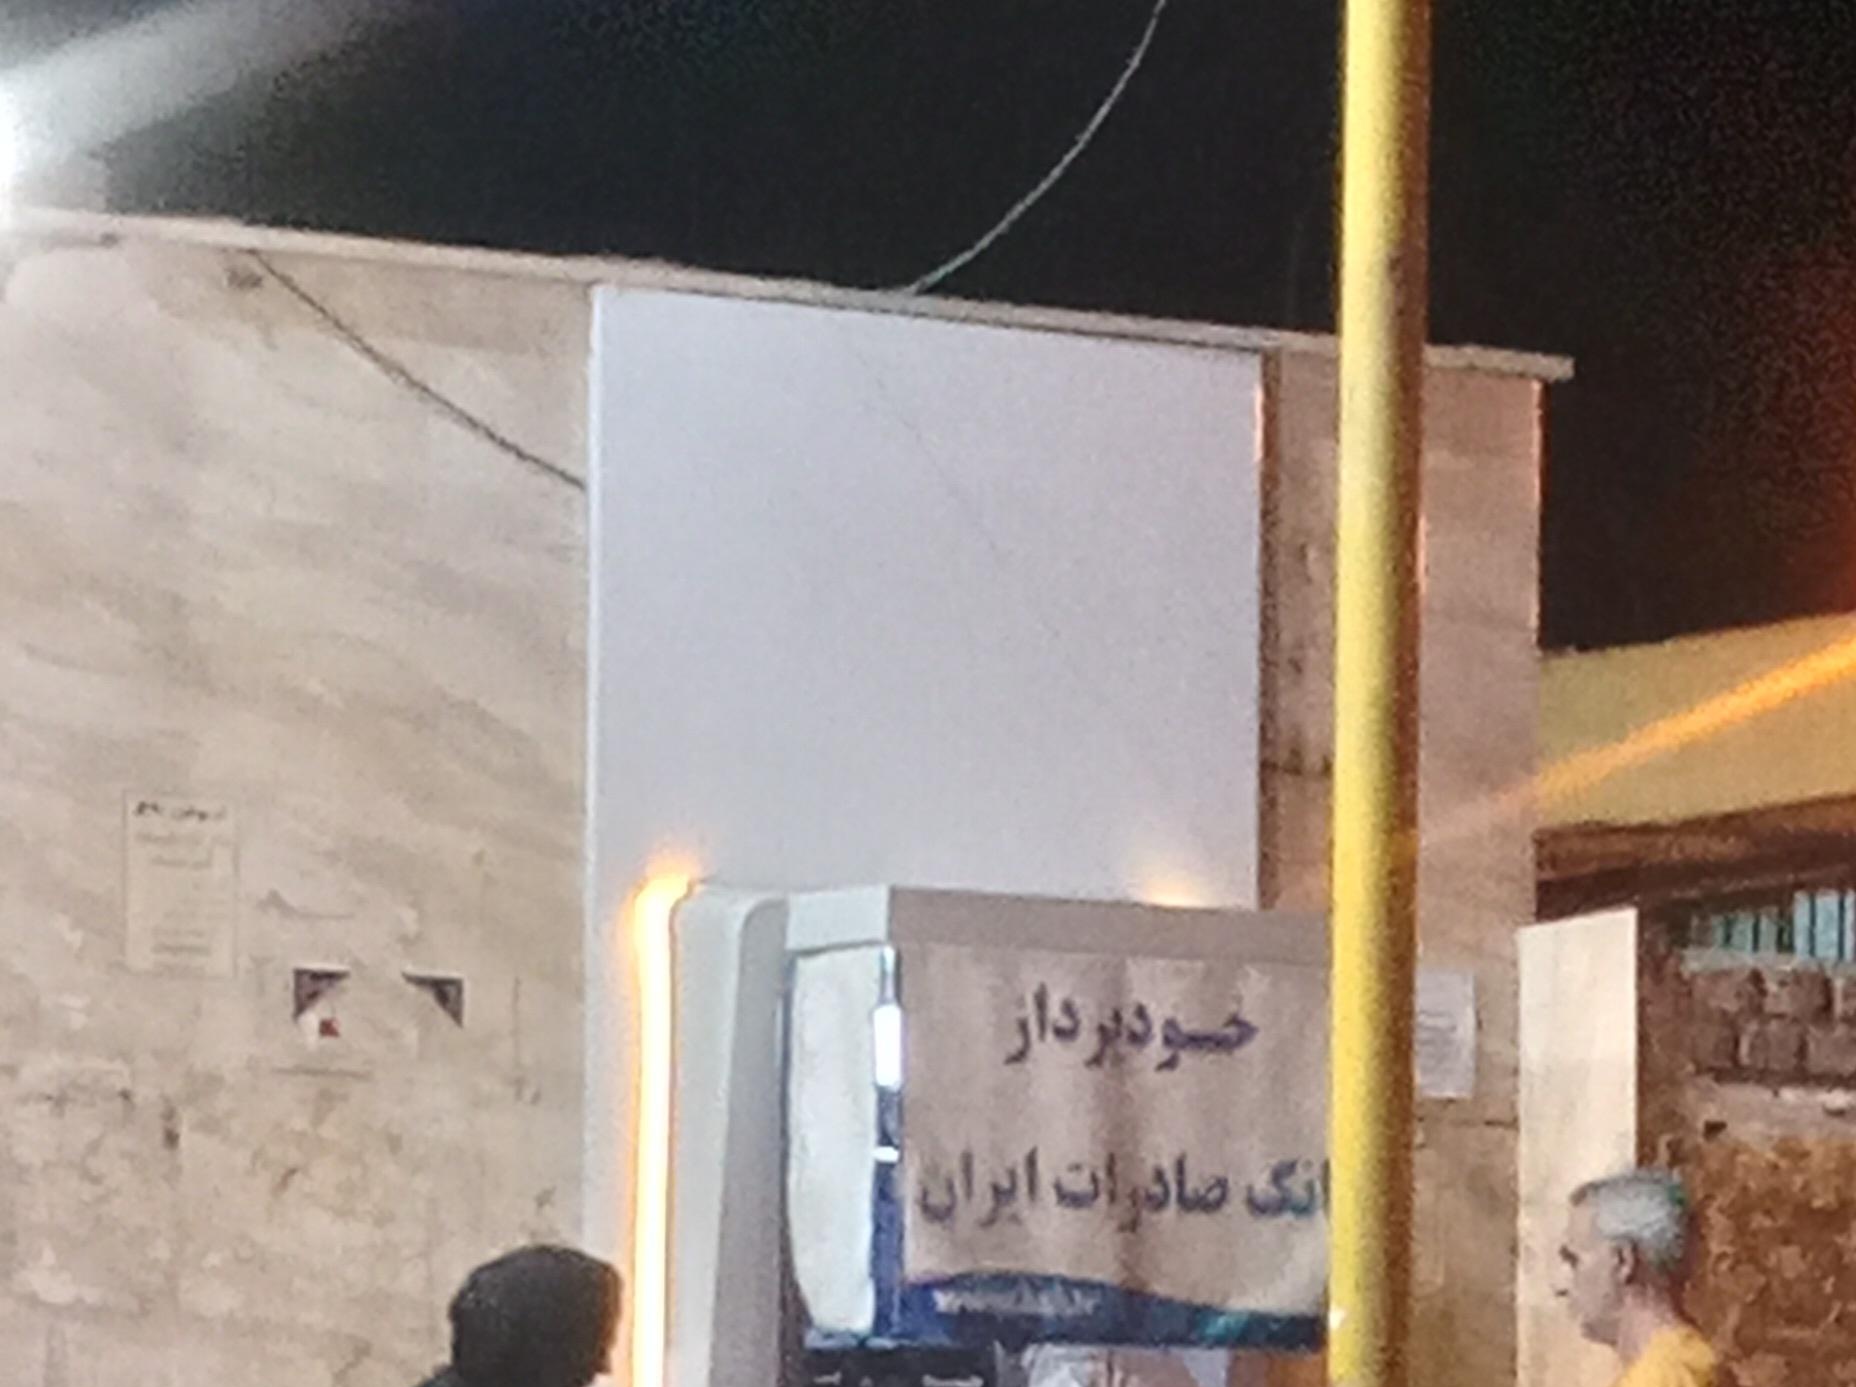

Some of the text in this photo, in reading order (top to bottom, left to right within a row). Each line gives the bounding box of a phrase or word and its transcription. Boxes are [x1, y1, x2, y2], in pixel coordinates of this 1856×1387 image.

[917, 1146, 1331, 1234] انک صادرات ایران
